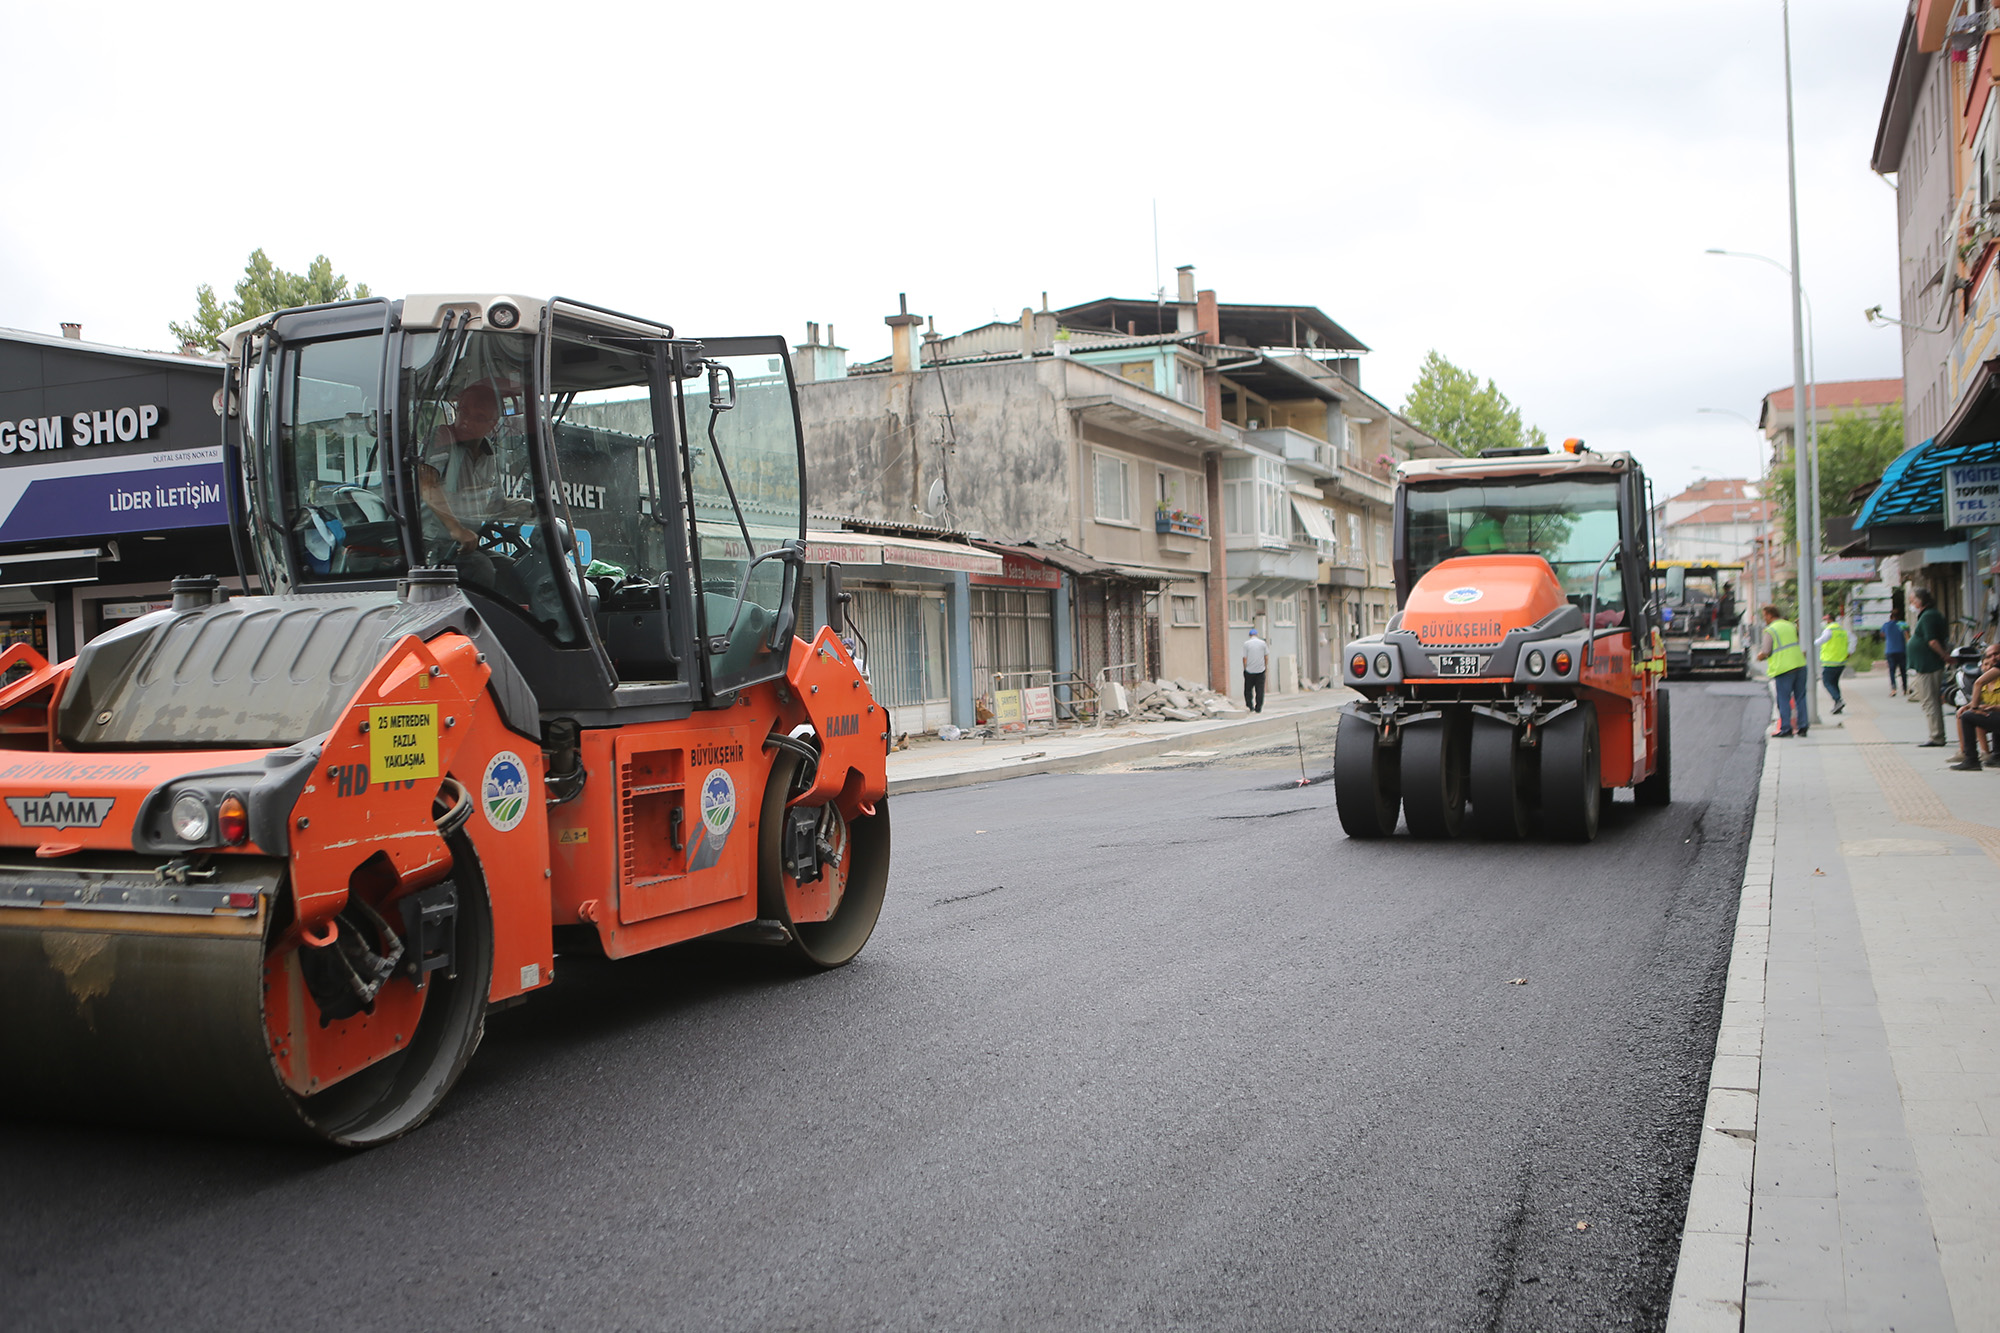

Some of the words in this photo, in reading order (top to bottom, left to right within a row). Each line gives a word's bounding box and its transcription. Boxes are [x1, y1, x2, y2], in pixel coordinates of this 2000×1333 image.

[0, 415, 63, 454] GSM
[72, 404, 159, 447] SHOP
[174, 452, 191, 462] SATIŞ
[191, 449, 218, 460] NOKTASI
[109, 487, 152, 512] LİDER
[156, 480, 220, 510] İLETİŞİM
[545, 479, 606, 510] ARKET
[1422, 619, 1501, 638] BÜYÜKŞEHİR
[1442, 657, 1453, 666] 54
[1455, 665, 1476, 675] 1571
[378, 716, 388, 729] 25
[390, 713, 430, 728] METREDEN
[826, 714, 859, 738] HAMM
[393, 734, 417, 748] FAZLA
[384, 753, 426, 769] YAKLAŞMA
[691, 740, 744, 768] BÜYÜKŞEHİR
[0, 760, 150, 781] BÜYÜKŞEHİR
[337, 763, 369, 798] HD
[23, 801, 98, 823] HAMM
